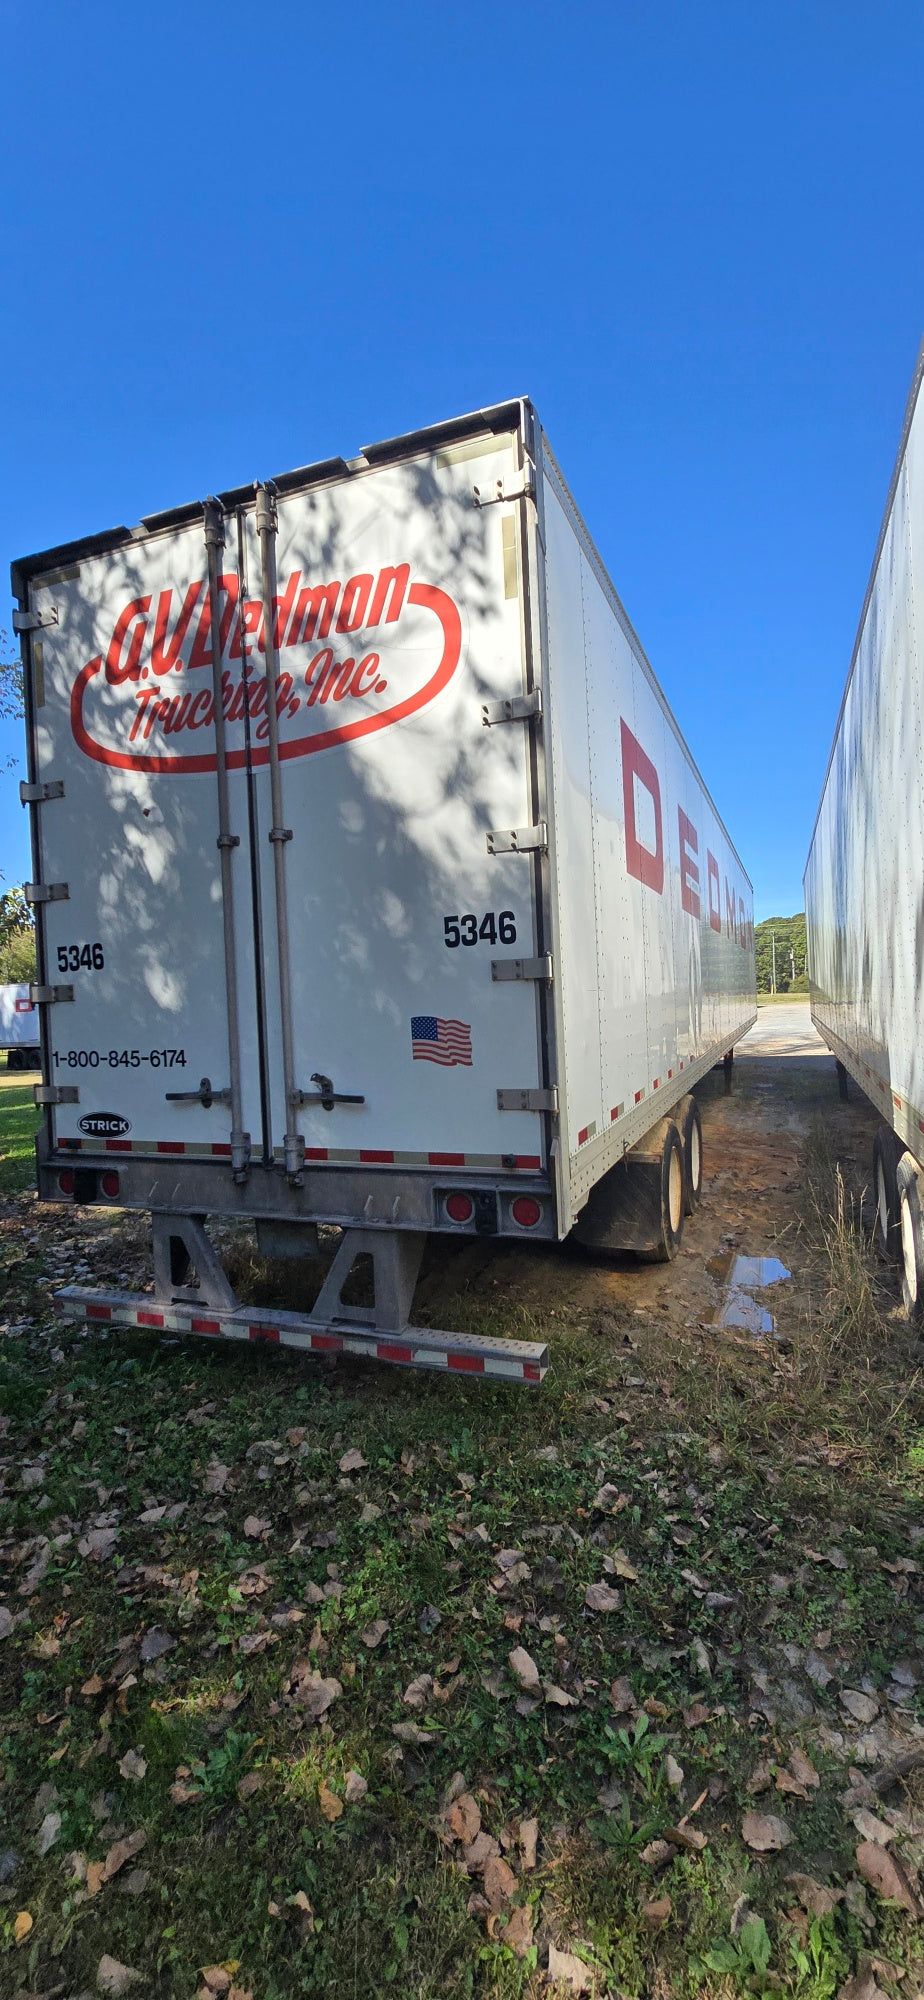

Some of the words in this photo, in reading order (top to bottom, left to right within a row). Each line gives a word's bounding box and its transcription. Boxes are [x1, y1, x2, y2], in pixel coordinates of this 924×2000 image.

[105, 580, 204, 686] G.V.
[188, 563, 411, 670] Dedmon
[129, 666, 301, 742] Trucking,
[305, 647, 388, 707] Inc.
[443, 910, 517, 948] 5346
[57, 943, 104, 972] 5346
[52, 1050, 187, 1068] 1-800-845-6174
[81, 1120, 128, 1131] STRICK
